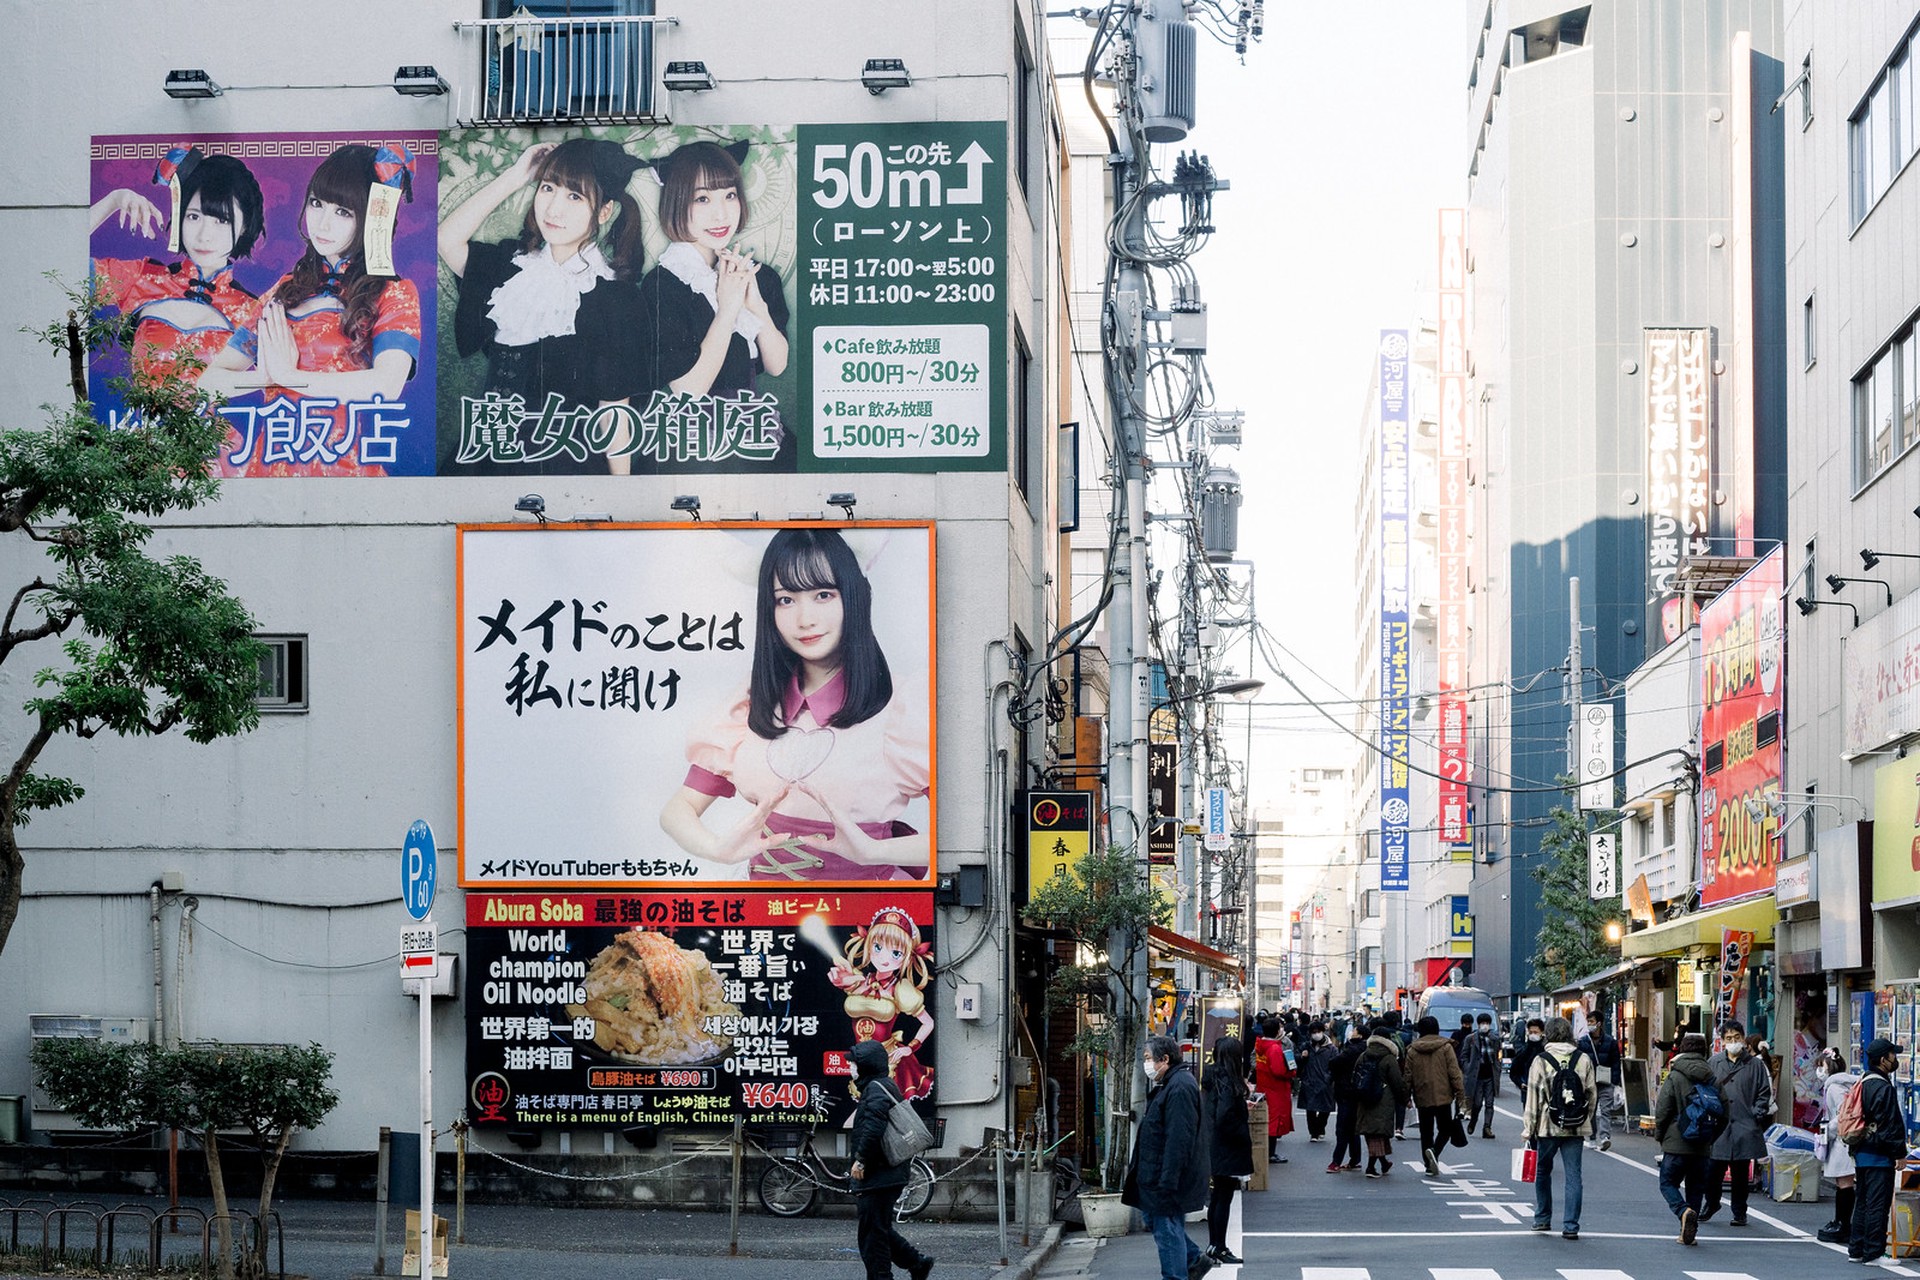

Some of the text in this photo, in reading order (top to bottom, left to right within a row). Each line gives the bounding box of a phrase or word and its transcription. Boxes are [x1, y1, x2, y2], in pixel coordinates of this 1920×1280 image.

[886, 141, 952, 165] この先
[812, 141, 941, 209] 50m
[809, 258, 849, 280] 平日
[809, 283, 849, 306] 休日
[455, 390, 781, 464] 魔女の箱庭
[474, 598, 745, 653] メイドのことは
[1760, 606, 1778, 640] CAFE
[1704, 606, 1756, 711] 13時間
[505, 650, 681, 717] 私に聞け
[1382, 798, 1408, 864] 駿河屋
[1444, 804, 1462, 839] 買取
[1718, 776, 1779, 873] 2000円
[409, 846, 423, 909] P
[479, 858, 699, 877] メイドYouTuberももちゃん
[418, 880, 428, 908] 60
[767, 897, 842, 916] 油ビーム！
[484, 898, 584, 922] Abura Soba
[594, 898, 747, 924] 最強の油そば
[508, 929, 567, 953] World
[720, 929, 797, 955] 世界で
[489, 956, 586, 984] champion
[711, 954, 807, 979] 一番旨い
[483, 981, 588, 1005] Oil Noodle
[722, 978, 795, 1004] 油そば
[480, 1016, 597, 1041] 世界第一的
[702, 1015, 820, 1036] 세상에서 가장
[503, 1045, 574, 1070] 油拌面
[733, 1036, 790, 1057] 맛있는
[660, 1069, 701, 1087] ¥690
[723, 1056, 798, 1077] 아부라면
[515, 1094, 644, 1110] 油そば専門店 春日亭
[653, 1094, 732, 1110] しょうゆ油そば
[741, 1082, 809, 1109] ¥640
[516, 1111, 553, 1123] There
[556, 1111, 568, 1123] is
[570, 1113, 578, 1123] a
[582, 1113, 616, 1123] menu
[620, 1111, 634, 1123] of
[637, 1111, 689, 1125] English,
[692, 1111, 747, 1124] Chines,
[750, 1111, 774, 1123] and
